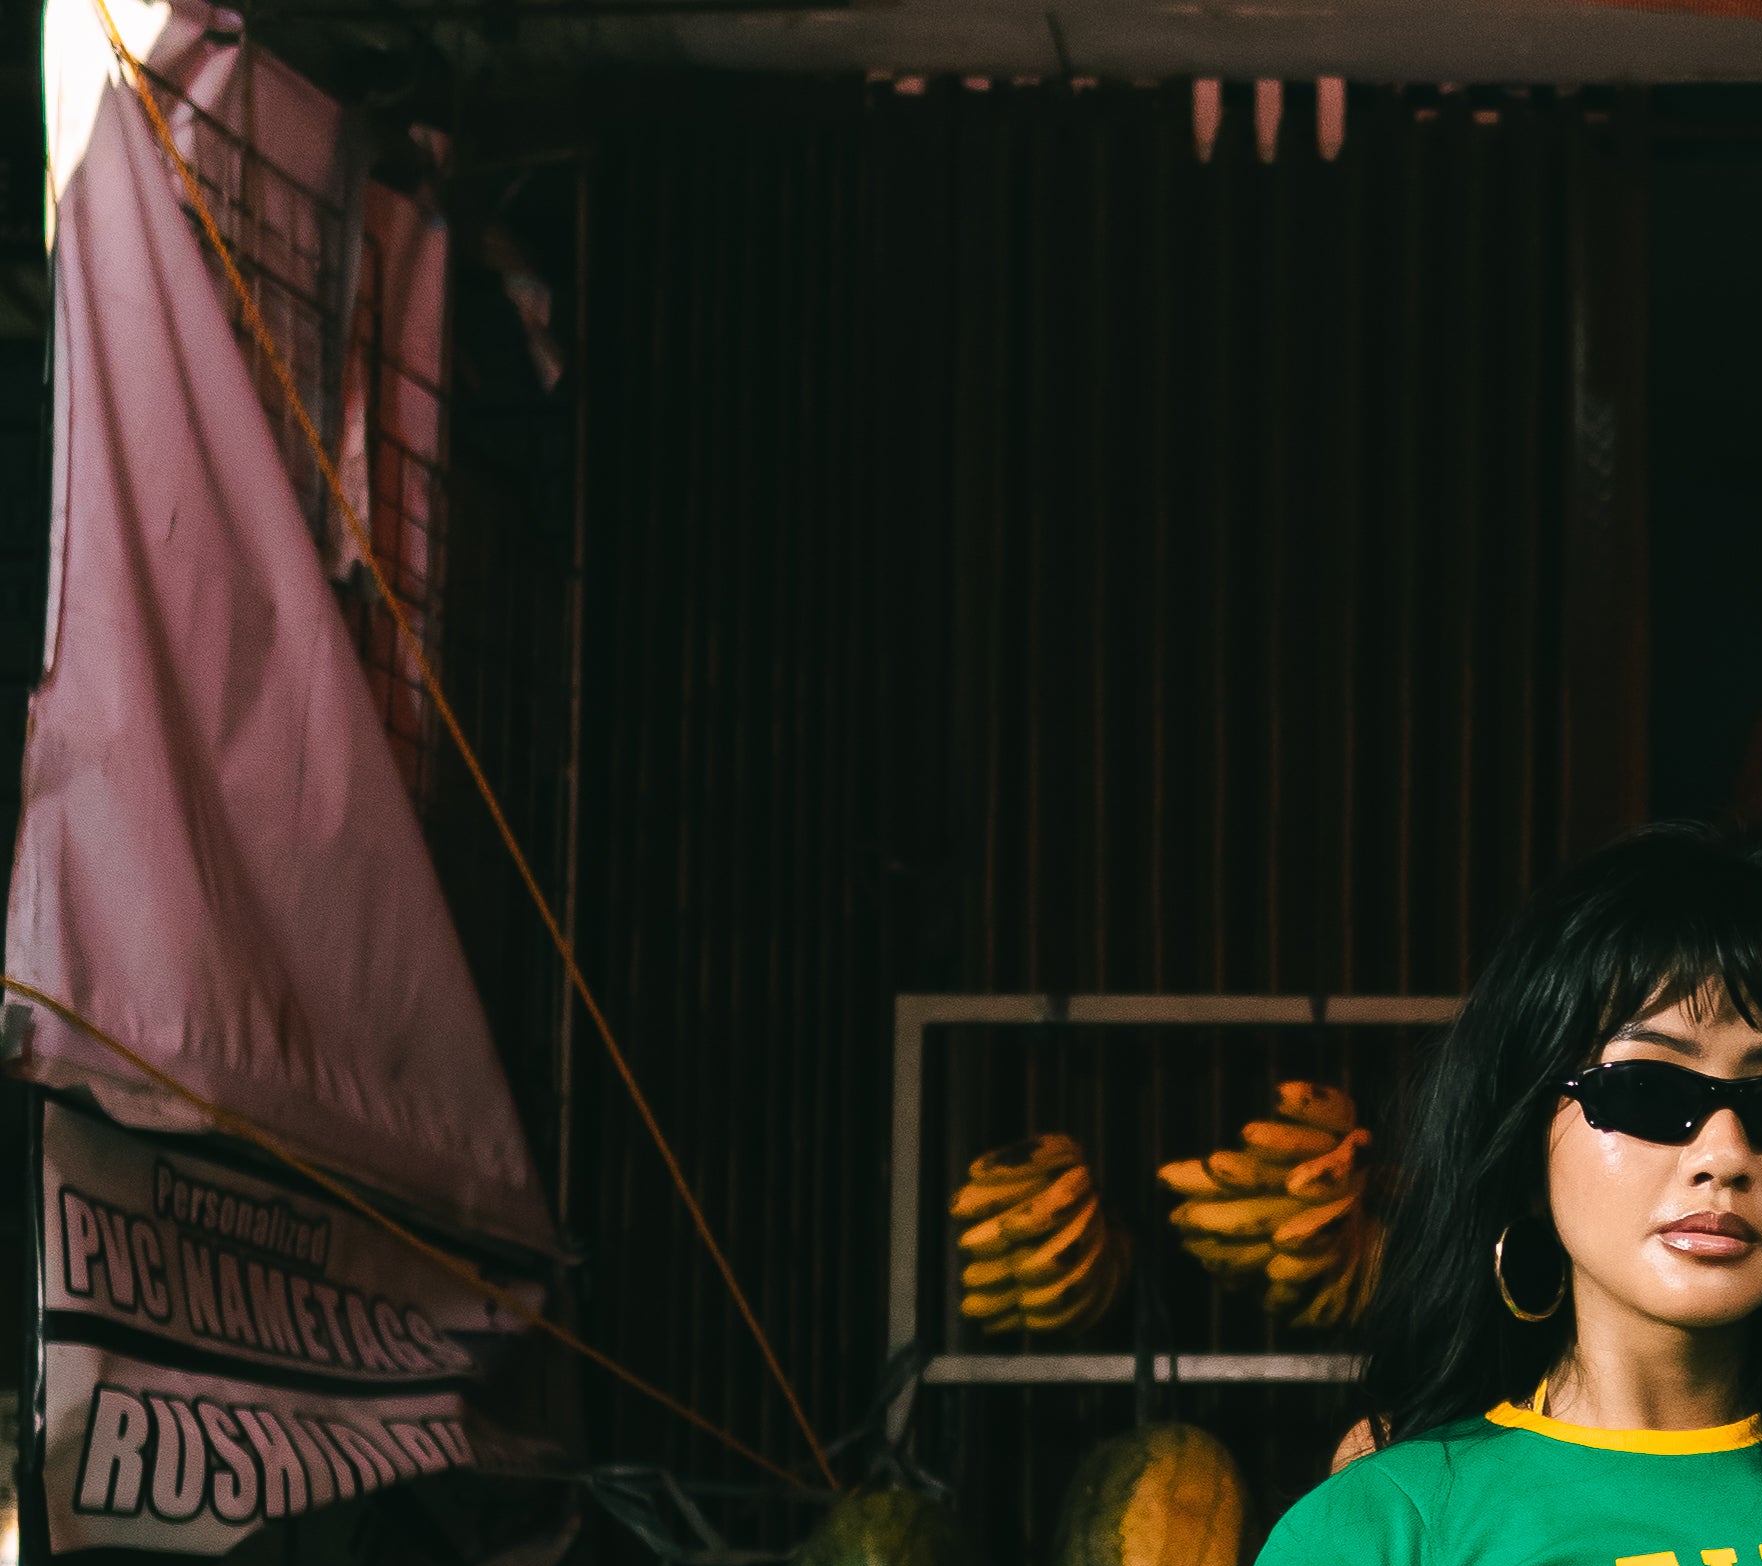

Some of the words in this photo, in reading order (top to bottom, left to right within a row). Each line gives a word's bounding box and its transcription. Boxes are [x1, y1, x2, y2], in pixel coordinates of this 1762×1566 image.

[58, 1184, 173, 1327] PVC
[178, 1232, 475, 1375] NAMETAGS
[155, 1162, 331, 1270] Personalized
[73, 1382, 309, 1526] RUSH
